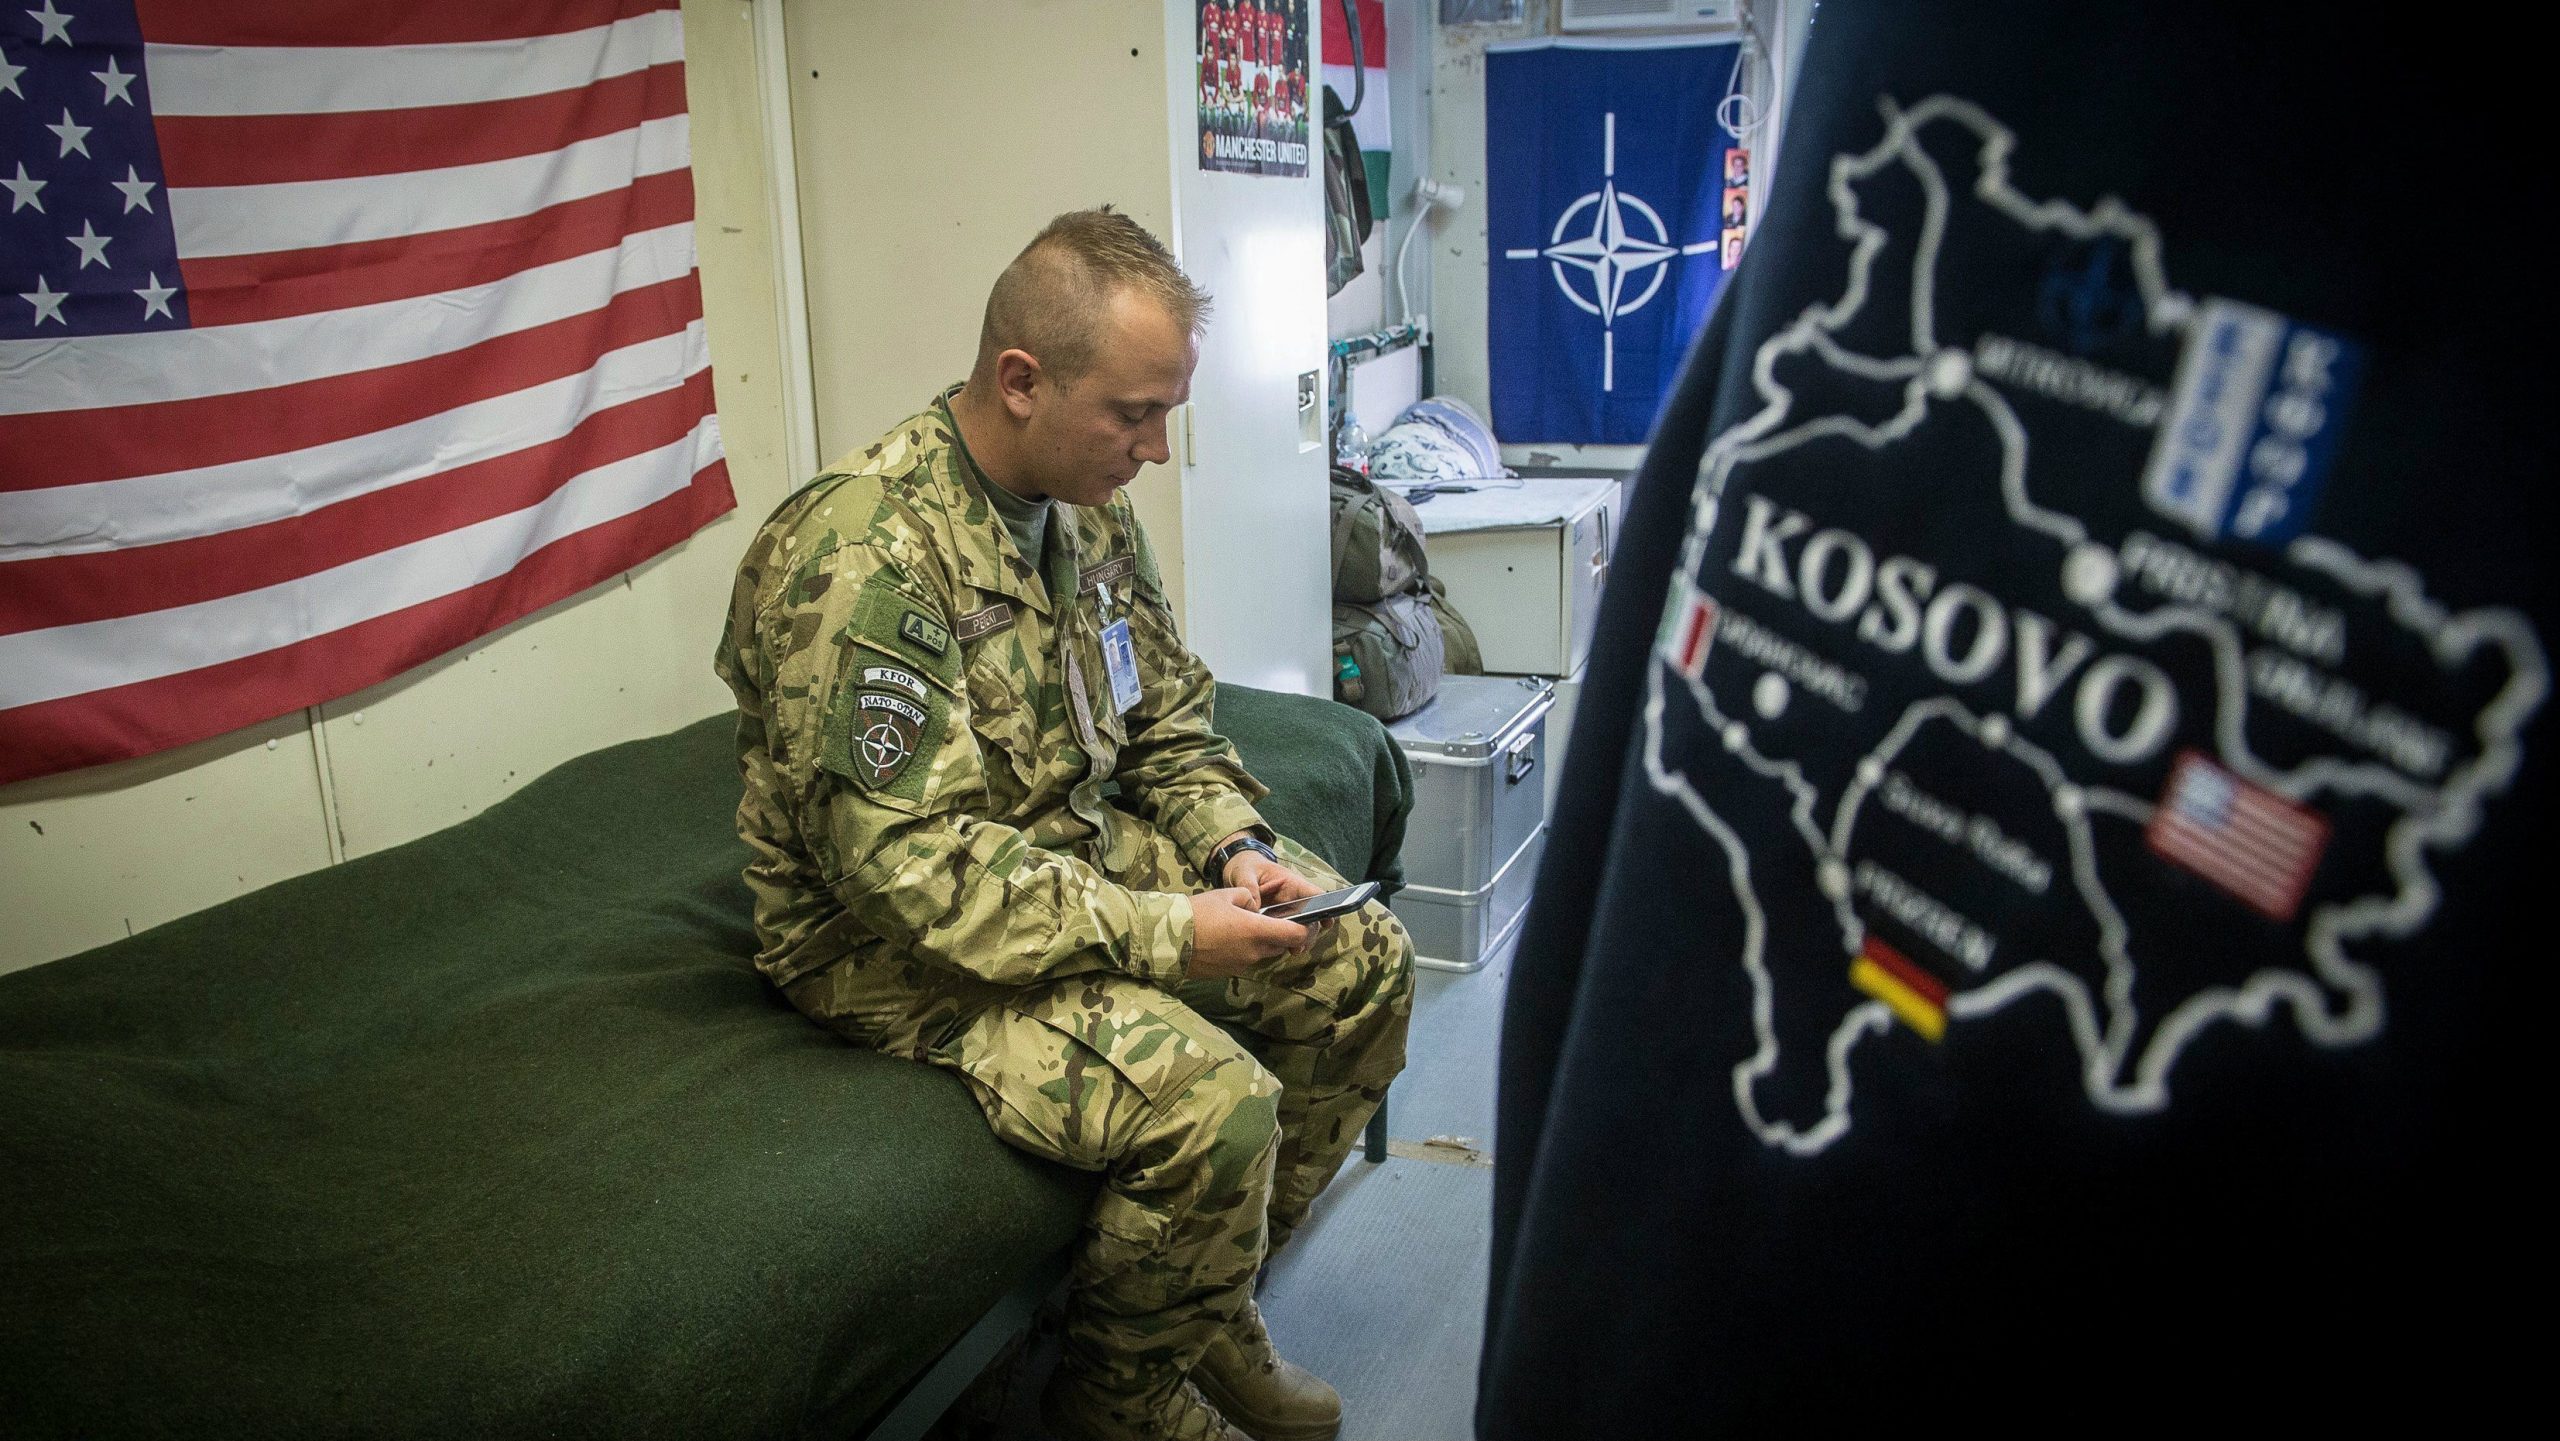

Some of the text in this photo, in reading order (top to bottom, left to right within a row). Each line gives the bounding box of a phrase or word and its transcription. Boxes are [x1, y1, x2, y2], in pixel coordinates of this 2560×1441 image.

[1216, 134, 1307, 165] MANCHESTER UNITED
[1086, 562, 1124, 588] HUNGARY
[907, 617, 925, 640] A
[1731, 494, 2179, 767] KOSOVO
[926, 634, 944, 649] POS
[879, 669, 916, 689] KFOR
